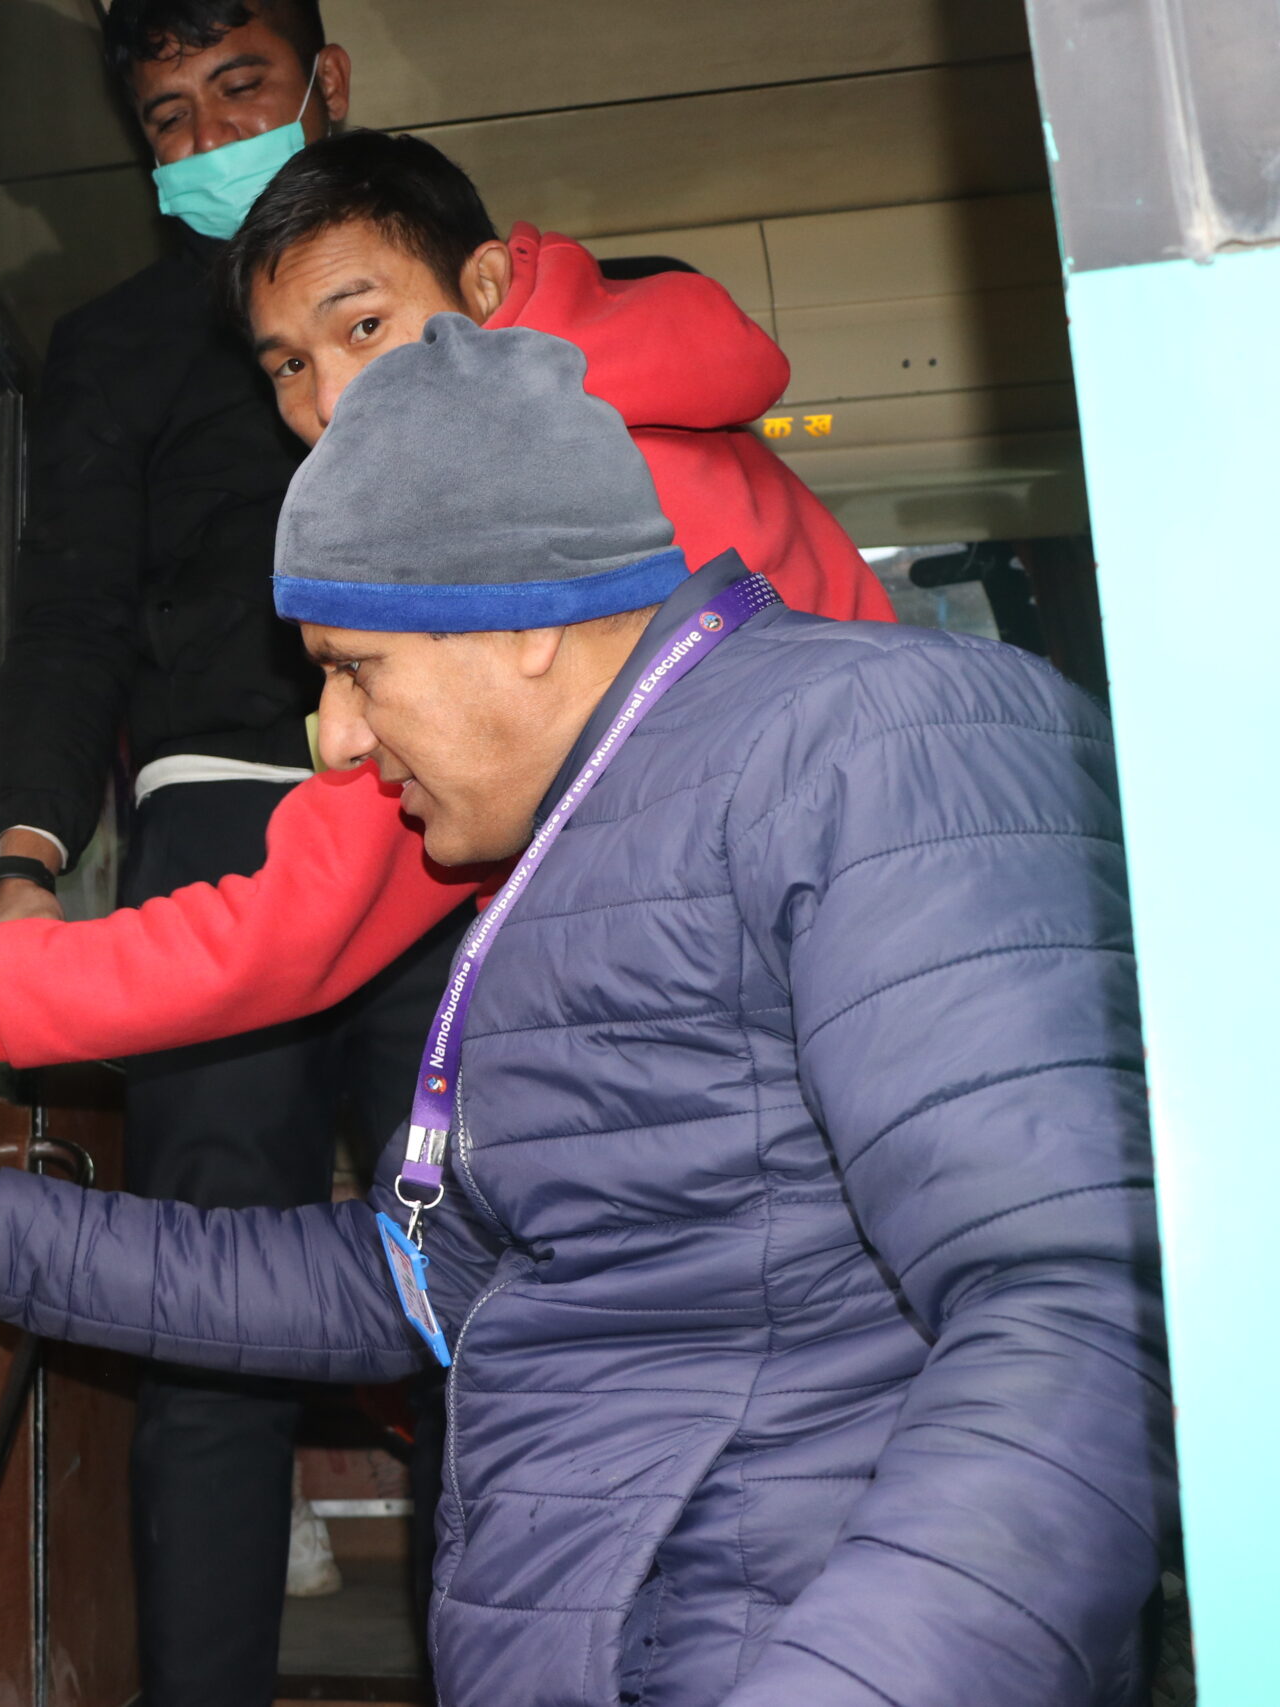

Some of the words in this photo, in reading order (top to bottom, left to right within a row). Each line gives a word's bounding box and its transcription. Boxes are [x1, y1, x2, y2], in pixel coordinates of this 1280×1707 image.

[763, 416, 794, 438] क
[803, 413, 833, 437] ख
[429, 961, 471, 1069] Namobuddha
[528, 814, 560, 859] Office
[561, 794, 574, 811] of
[573, 769, 593, 793] the
[590, 693, 645, 767] Municipal
[640, 630, 702, 692] Executive
